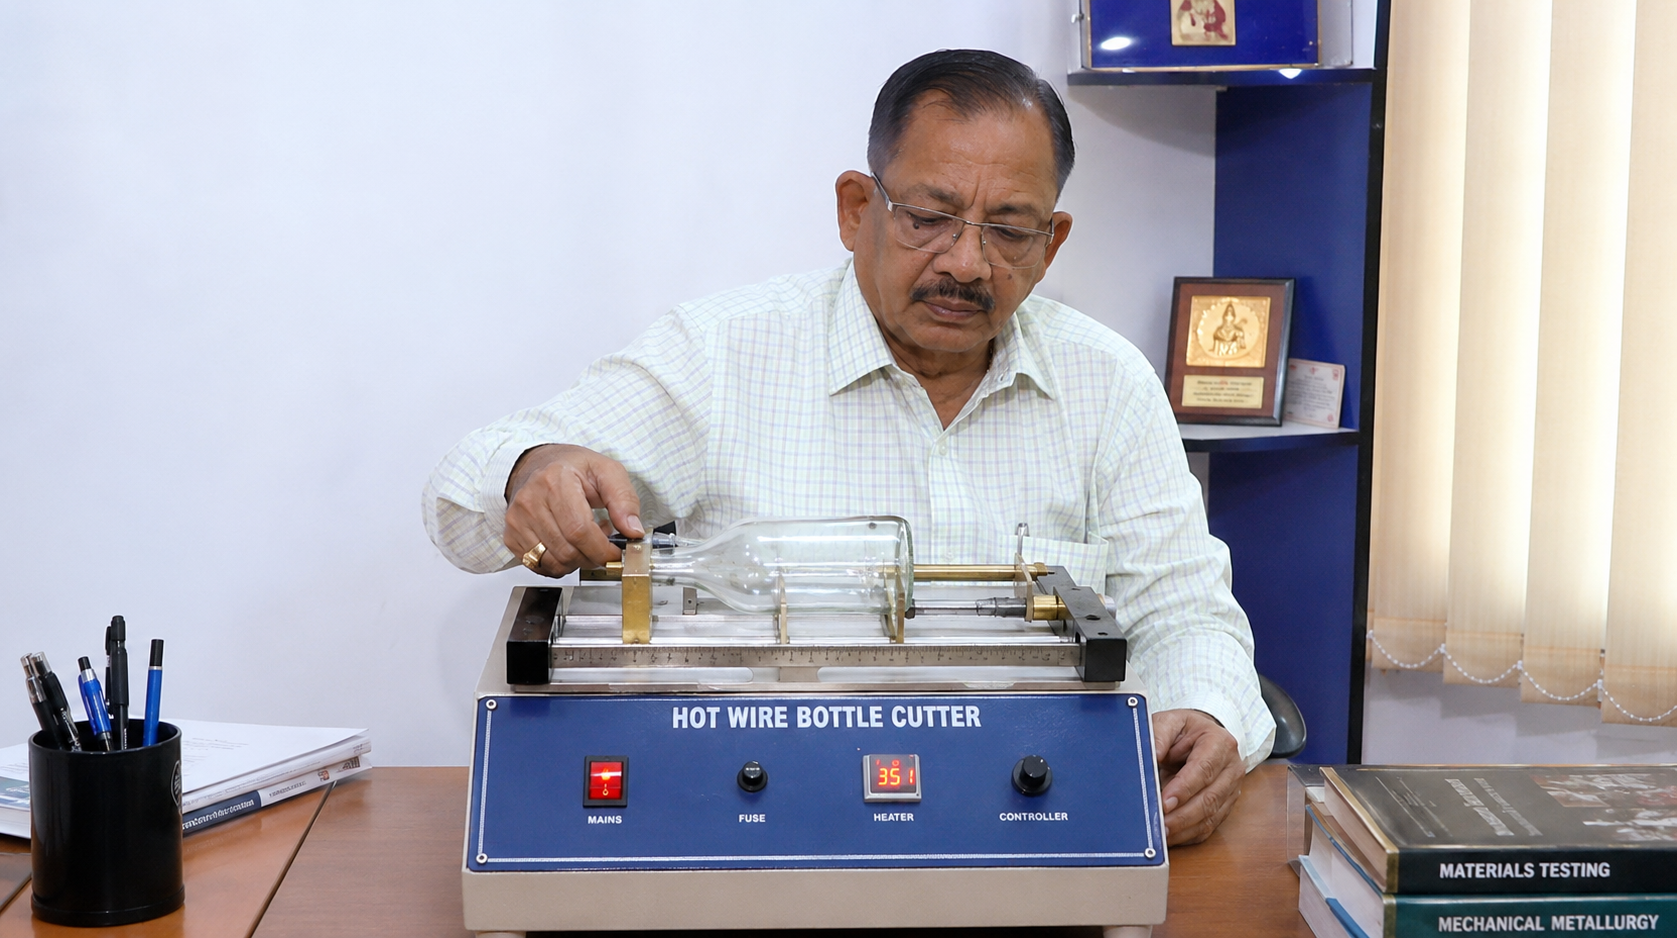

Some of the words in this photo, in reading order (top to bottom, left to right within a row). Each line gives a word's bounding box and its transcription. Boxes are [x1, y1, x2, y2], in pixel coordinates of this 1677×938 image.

[672, 706, 720, 729] HOT
[727, 706, 789, 729] WIRE
[797, 706, 884, 729] BOTTLE
[892, 705, 982, 728] CUTTER
[587, 815, 623, 825] MAINS
[738, 813, 766, 823] FUSE
[873, 812, 914, 822] HEATER
[999, 812, 1069, 823] CONTROLLER
[1439, 863, 1535, 880] MATERIALS
[1540, 862, 1611, 879] TESTING
[1438, 915, 1546, 933] MECHANICAL
[1551, 914, 1660, 932] METALLURGY
